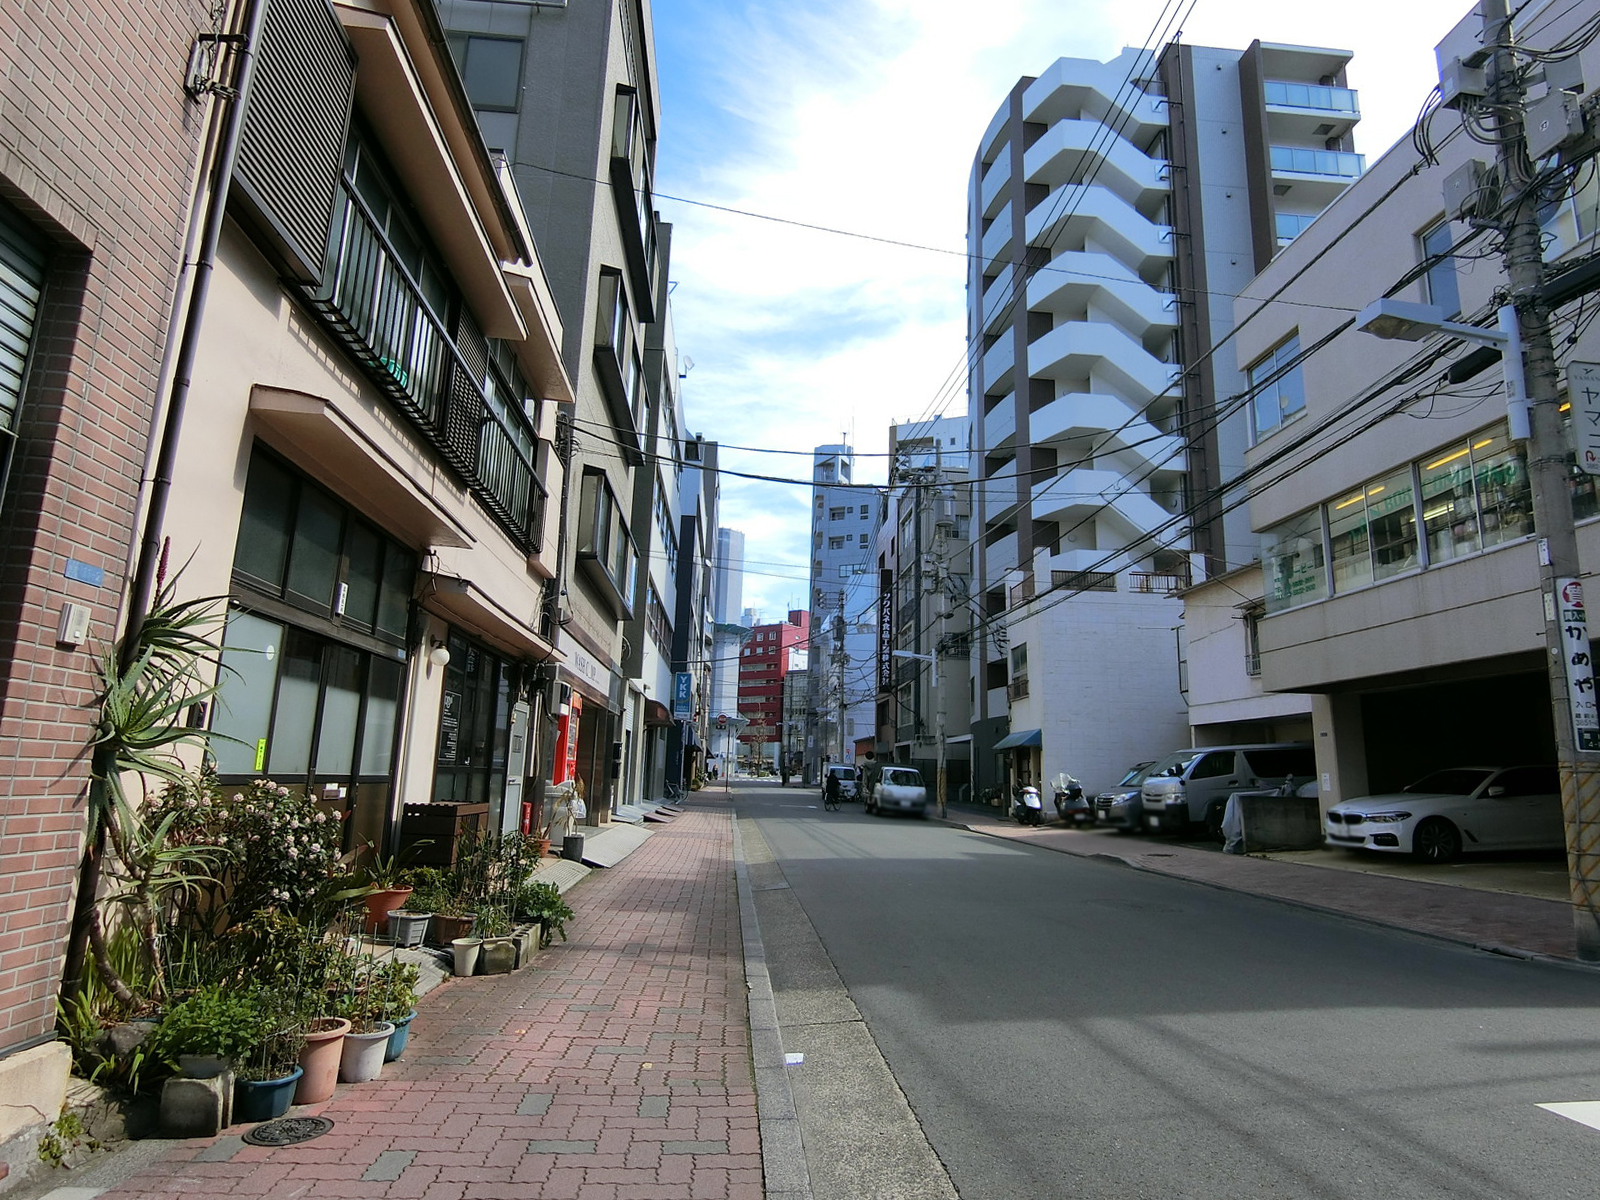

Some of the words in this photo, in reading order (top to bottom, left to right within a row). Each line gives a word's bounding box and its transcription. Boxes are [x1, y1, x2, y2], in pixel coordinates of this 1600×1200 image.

[1565, 625, 1593, 694] かめや
[679, 675, 688, 698] YKK
